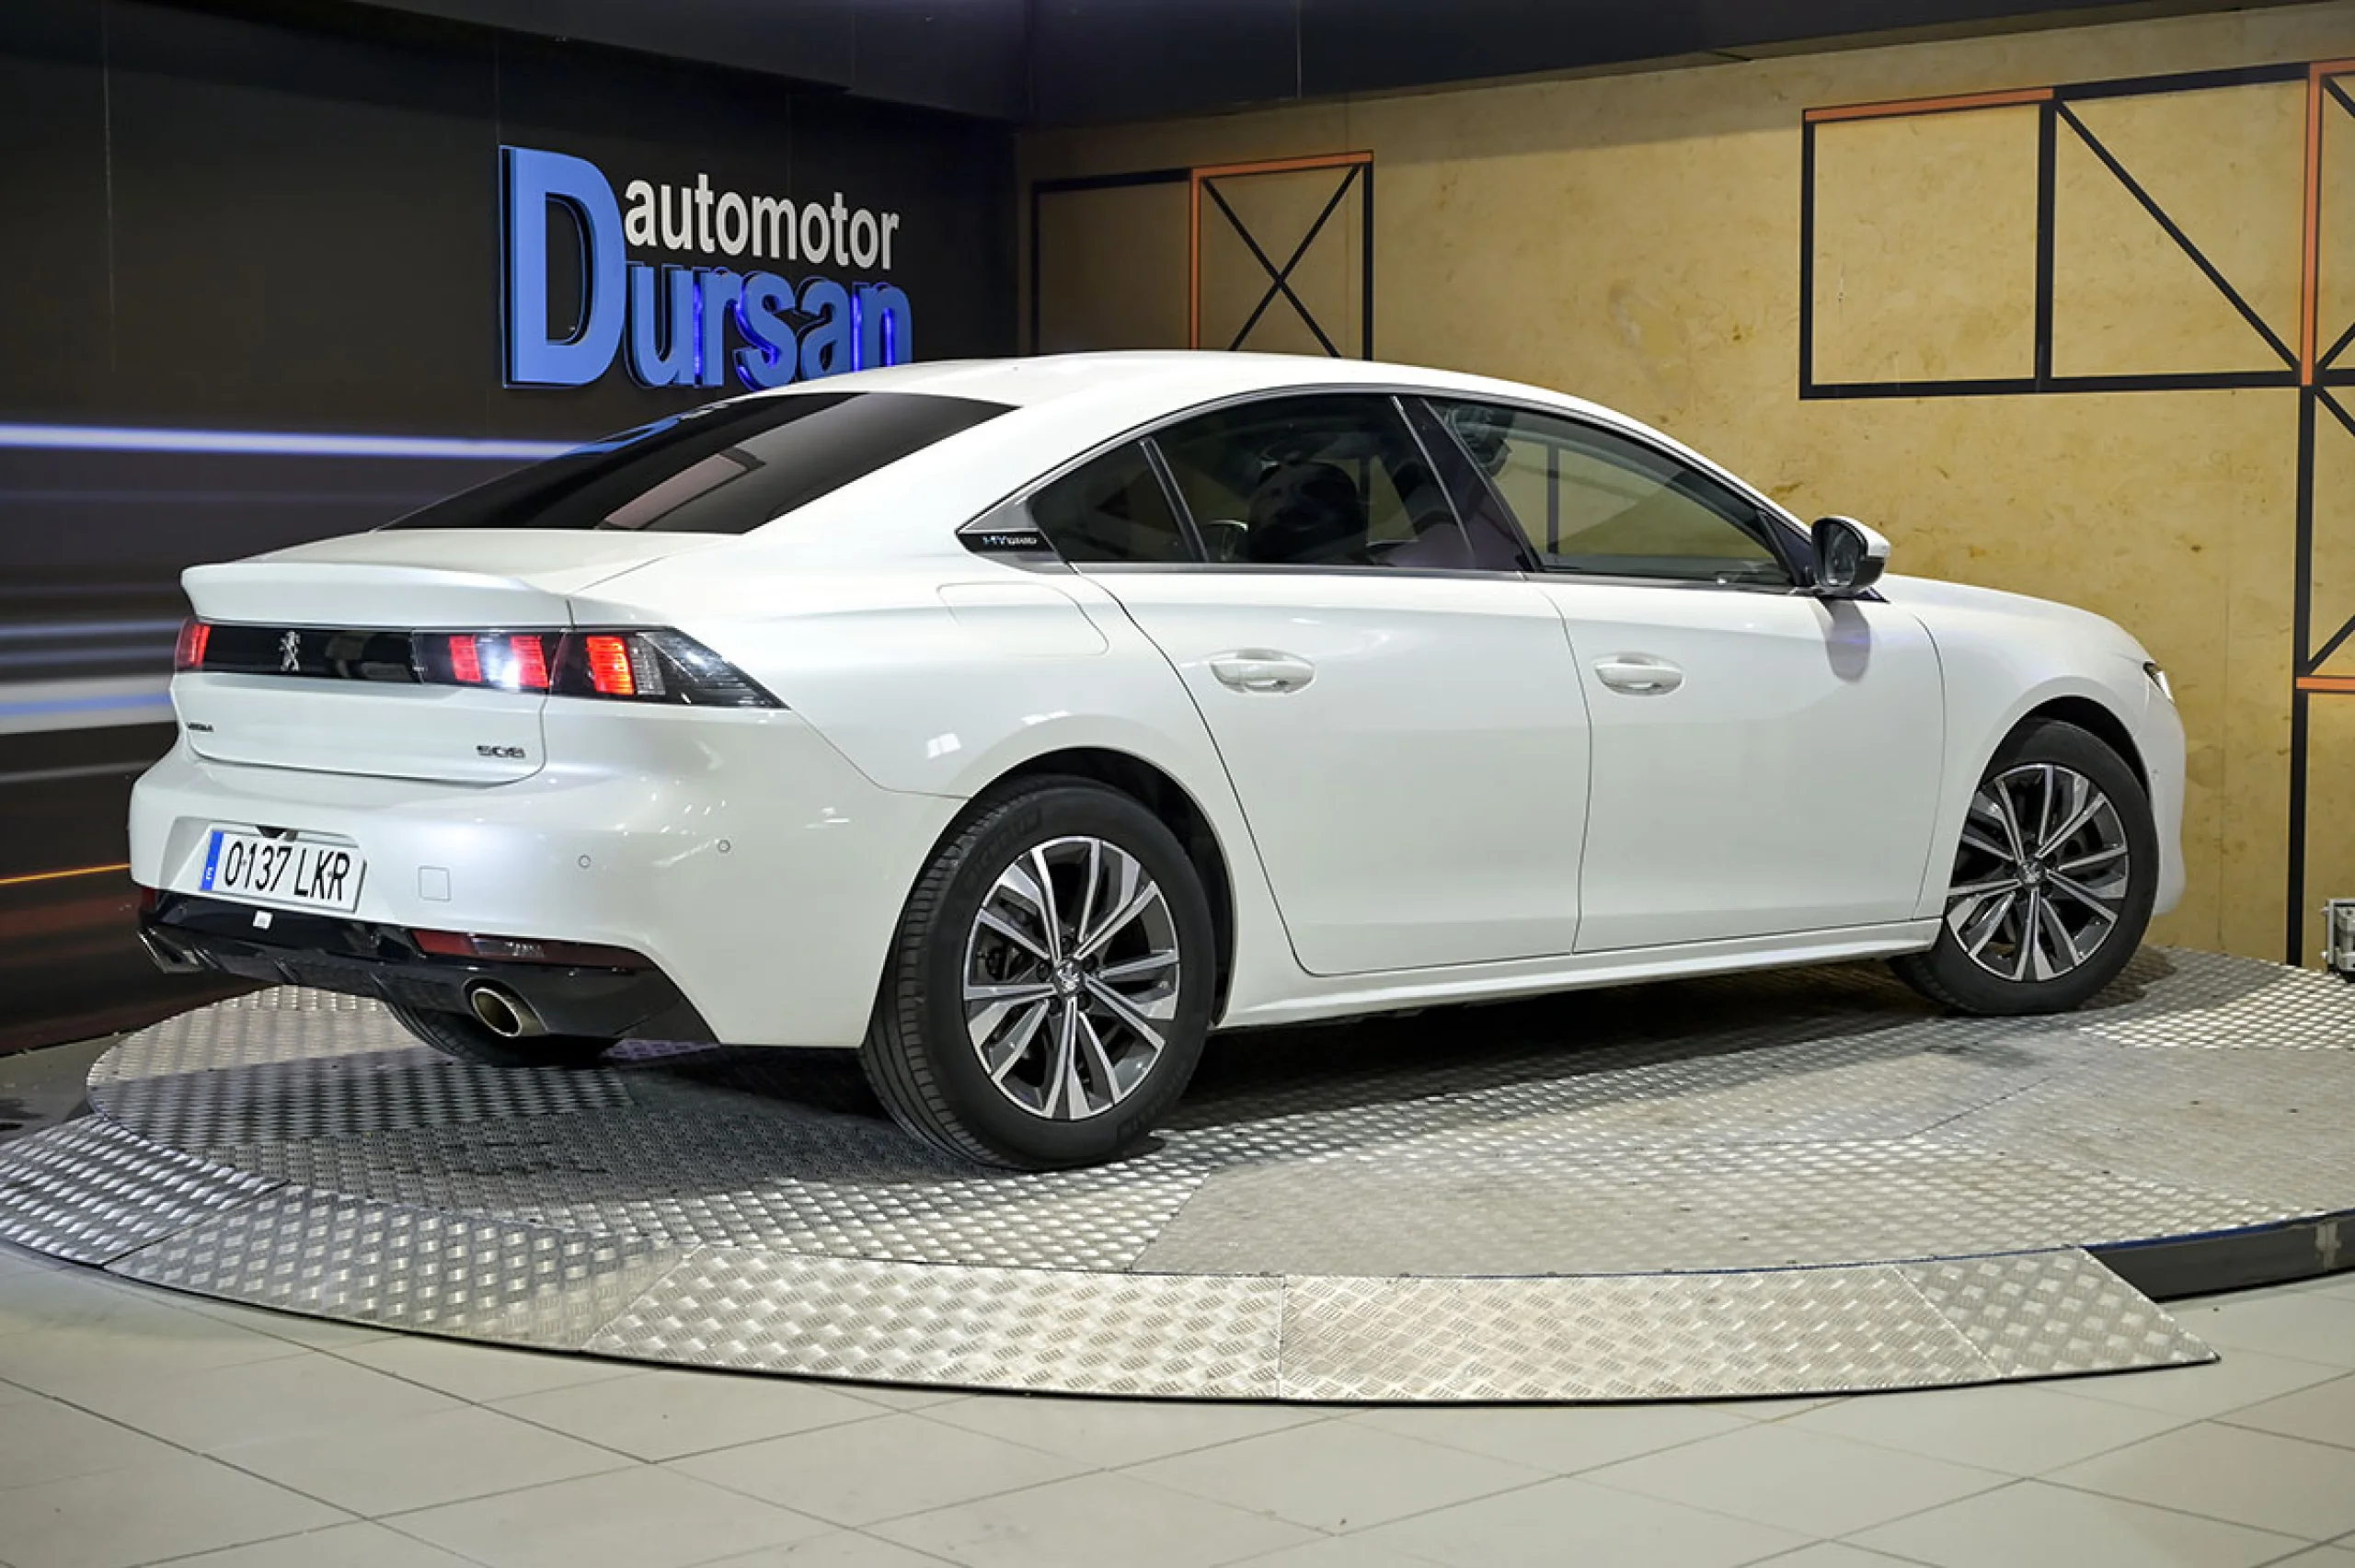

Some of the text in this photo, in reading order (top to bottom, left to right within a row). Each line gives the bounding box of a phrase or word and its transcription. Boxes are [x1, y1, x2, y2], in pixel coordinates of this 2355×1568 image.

[499, 144, 913, 391] Dursan
[625, 172, 900, 270] automotor
[224, 841, 350, 902] 0137 LKR
